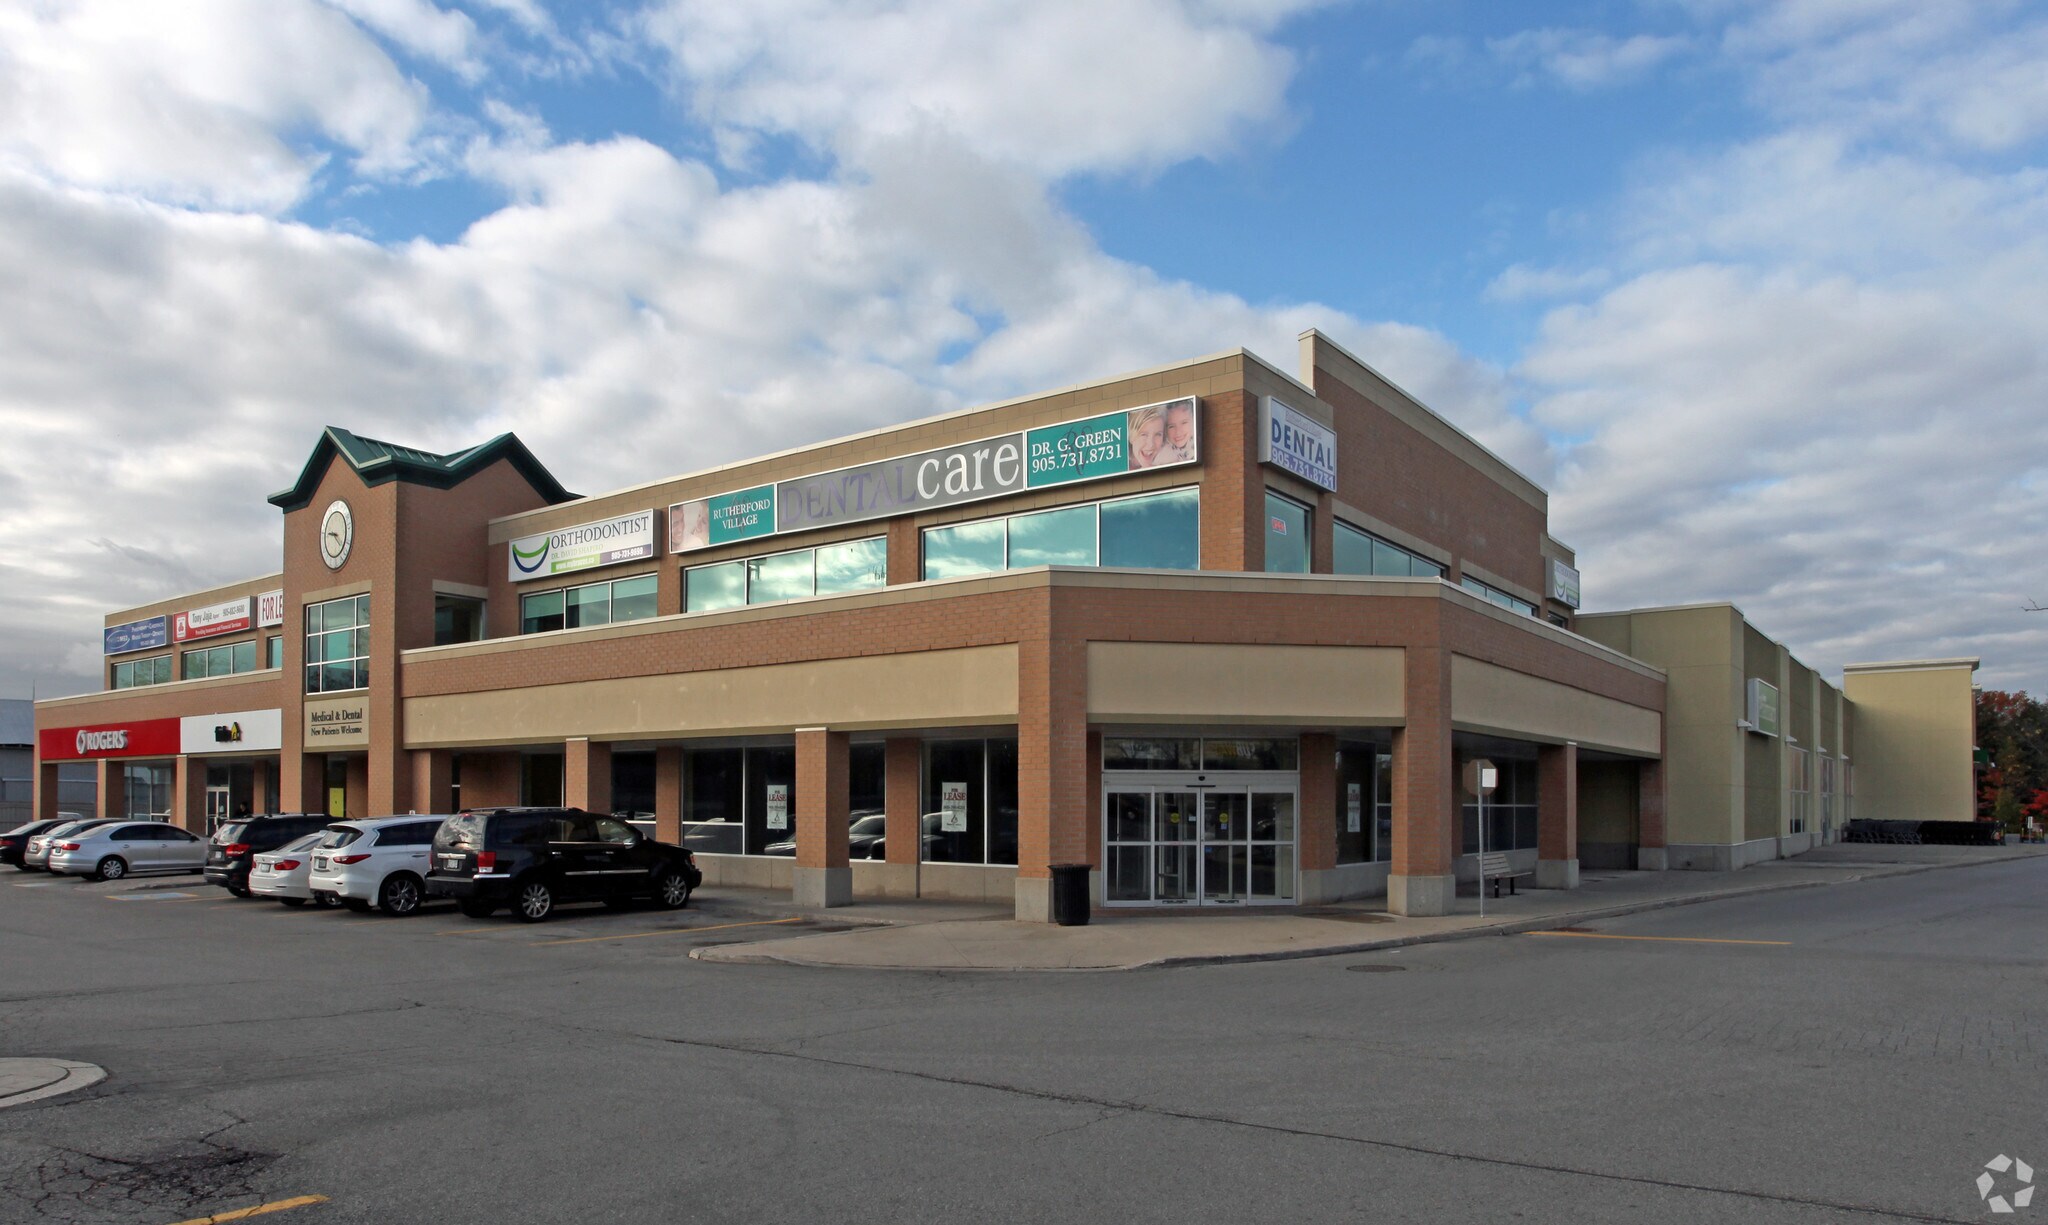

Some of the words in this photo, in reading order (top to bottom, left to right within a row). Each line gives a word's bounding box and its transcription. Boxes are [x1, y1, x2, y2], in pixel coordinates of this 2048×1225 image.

[1032, 441, 1054, 457] DR.
[1057, 438, 1071, 452] G.
[1074, 427, 1122, 449] GREEN
[1271, 417, 1334, 472] DENTAL
[1032, 443, 1122, 474] 905.731.8731
[1271, 447, 1335, 490] 905.731.8731
[713, 498, 771, 520] RUTHERFORD
[551, 516, 649, 549] ORTHODONTIST
[722, 514, 758, 529] VILLAGE
[192, 613, 202, 624] Tony
[262, 596, 274, 621] FOR
[311, 710, 334, 722] Medical
[335, 711, 340, 720] &
[341, 707, 363, 720] Dental
[86, 729, 127, 750] ROGERS
[943, 792, 966, 800] LEASE
